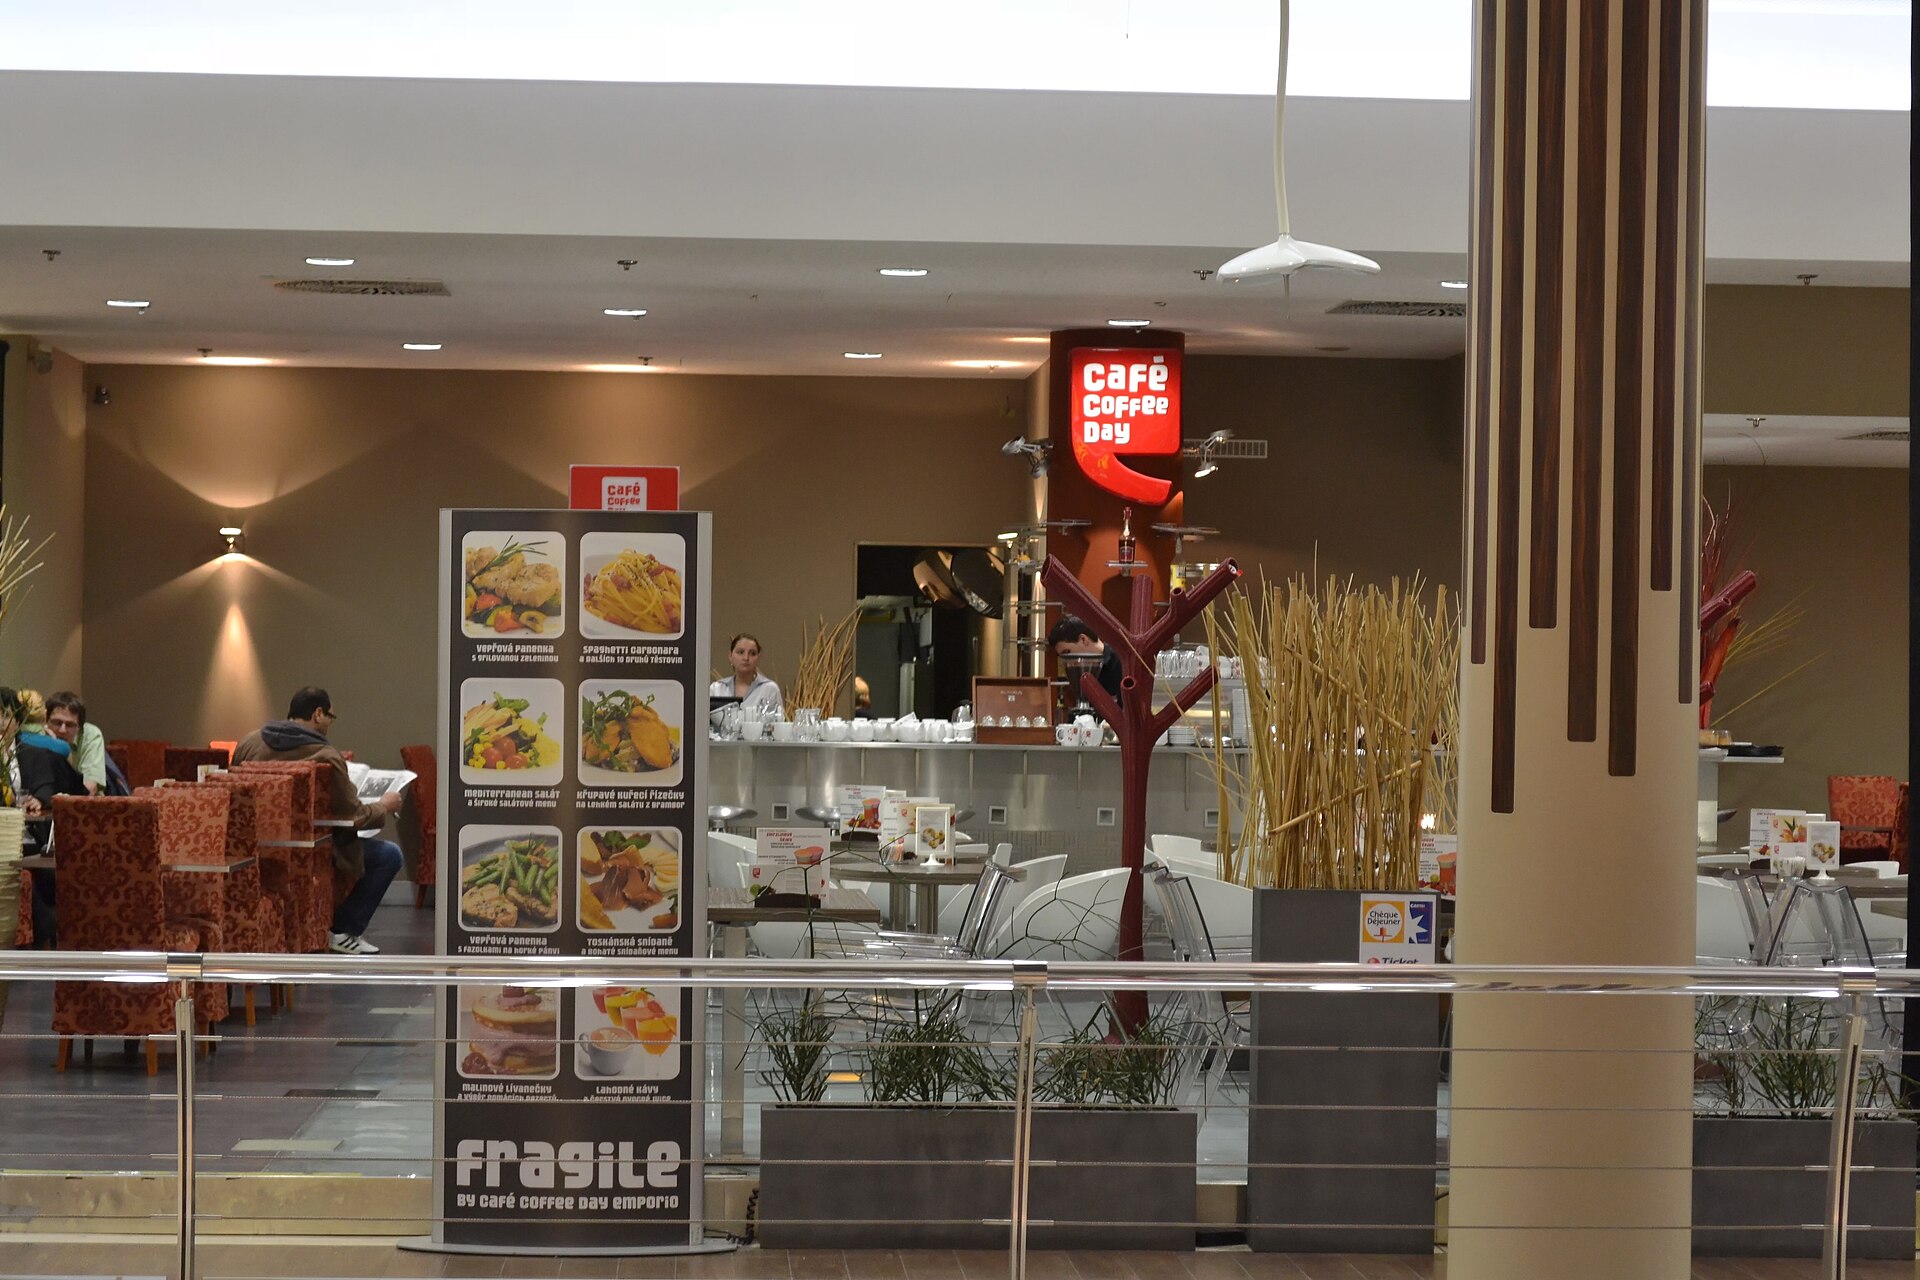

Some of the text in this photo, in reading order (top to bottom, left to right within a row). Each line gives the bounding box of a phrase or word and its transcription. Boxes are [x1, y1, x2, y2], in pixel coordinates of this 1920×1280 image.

[1083, 355, 1168, 392] Café
[1083, 394, 1169, 418] Coffee
[1083, 421, 1130, 444] Day
[607, 482, 640, 496] Café
[607, 497, 640, 506] Coffee
[1367, 917, 1400, 926] Déjeuner
[1370, 911, 1399, 919] Chèque
